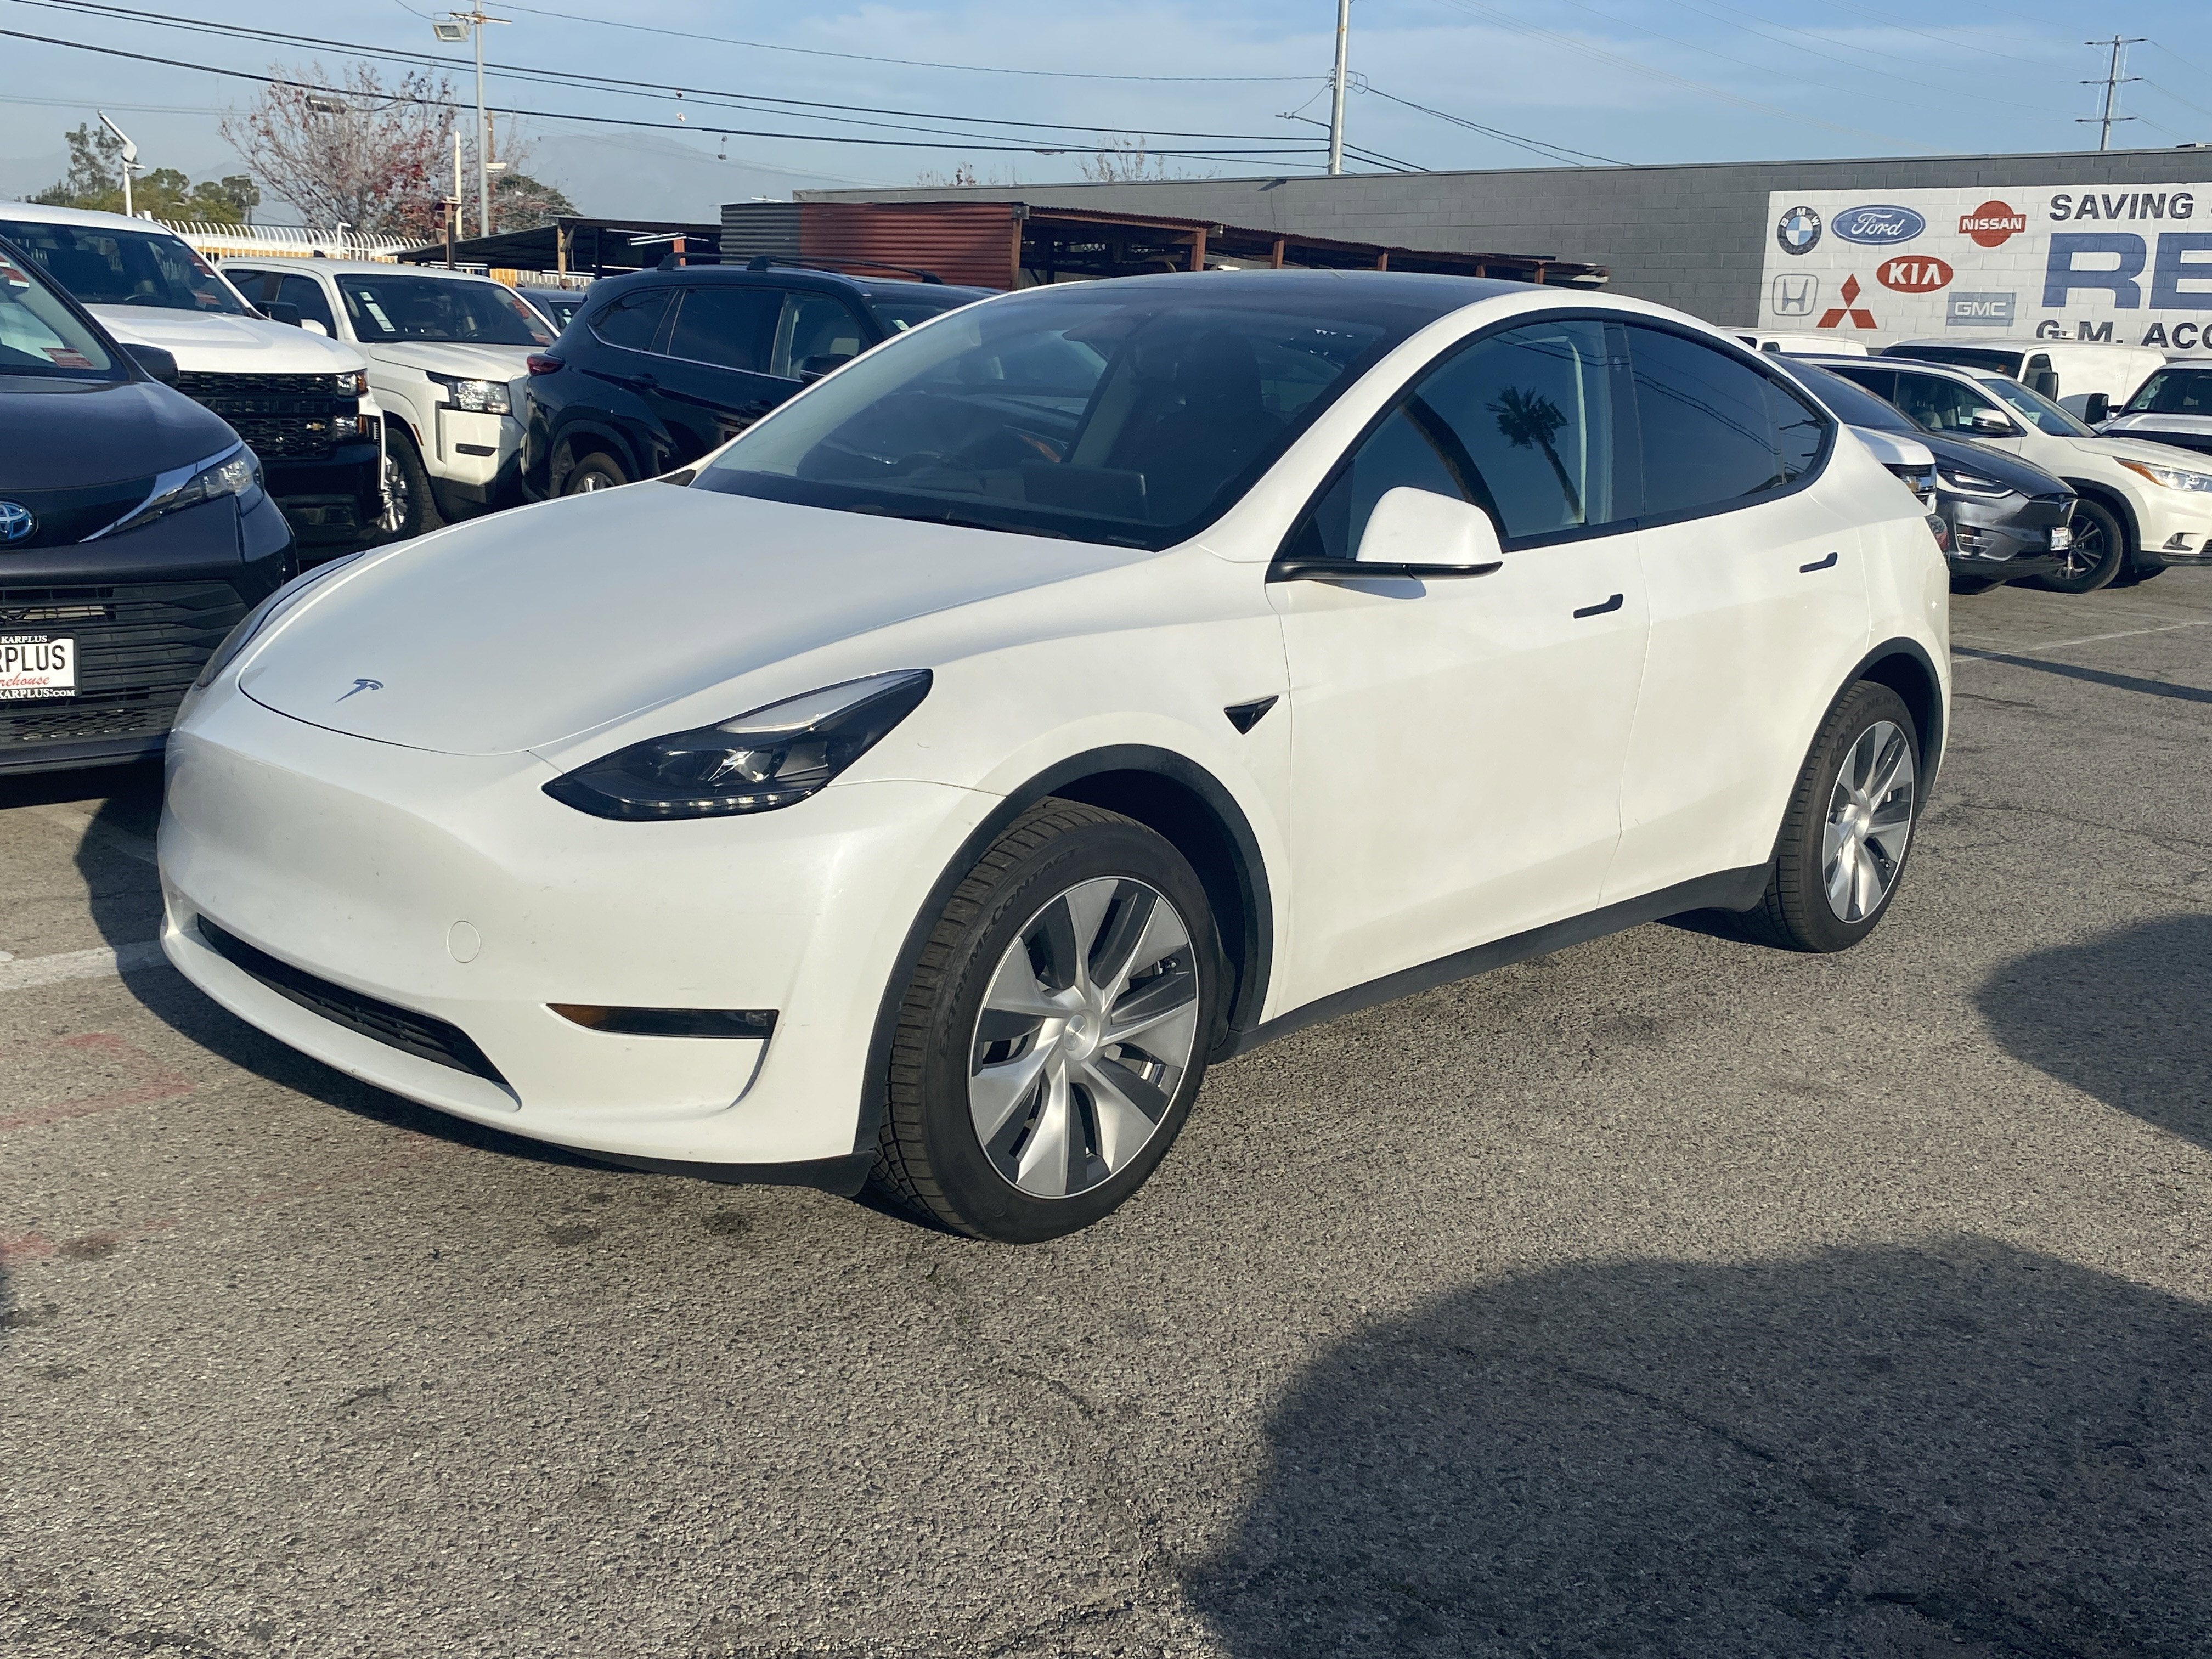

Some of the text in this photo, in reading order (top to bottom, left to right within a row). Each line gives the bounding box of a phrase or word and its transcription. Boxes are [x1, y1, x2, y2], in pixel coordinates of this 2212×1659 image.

[1780, 207, 1820, 227] BMW
[2049, 192, 2194, 221] SAVING
[1851, 213, 1905, 235] Ford
[1962, 218, 2022, 230] NISSAN
[1888, 263, 1942, 285] KIA
[1954, 302, 2007, 316] GMC
[2036, 320, 2124, 343] GM.
[1, 635, 48, 644] KARPLUS
[0, 645, 65, 673] PLUS
